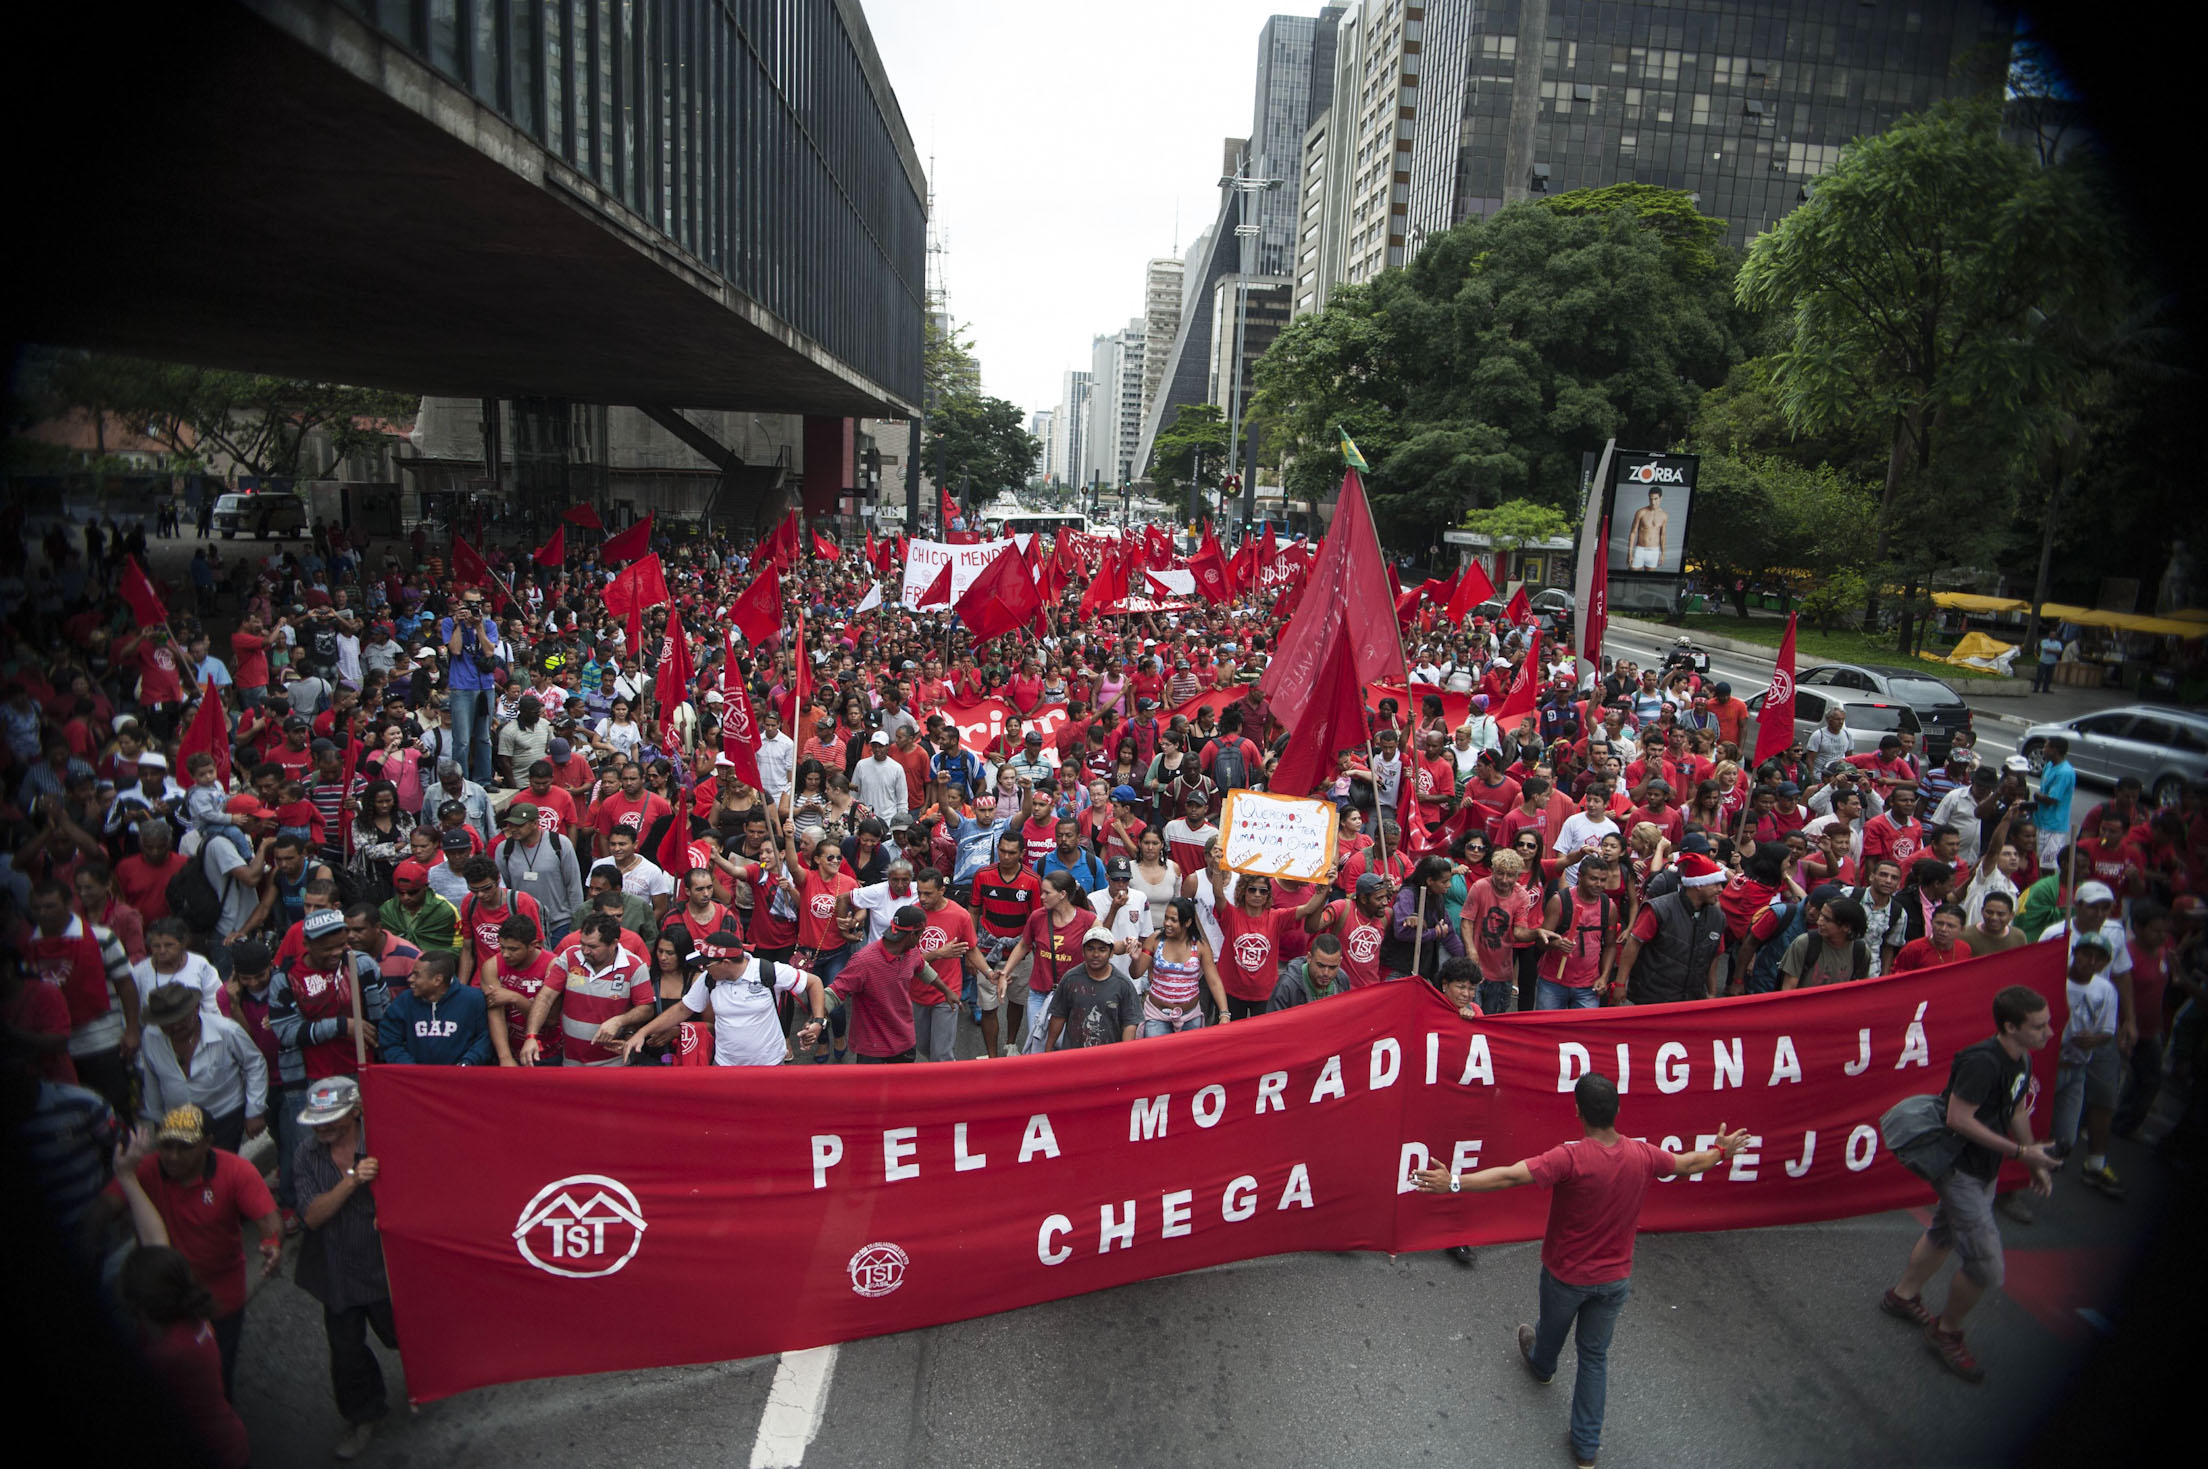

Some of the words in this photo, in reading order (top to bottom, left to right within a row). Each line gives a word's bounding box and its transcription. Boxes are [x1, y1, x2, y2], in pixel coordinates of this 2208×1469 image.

[1628, 460, 1683, 483] ZORBA
[912, 546, 949, 566] CHICO
[611, 973, 625, 991] 2
[414, 1018, 458, 1037] GAP
[810, 1113, 1061, 1189] PELA
[1128, 1032, 1496, 1142] MORADIA
[1556, 1034, 1802, 1095] DIGNA
[1843, 1000, 1929, 1077] JÁ
[1036, 1163, 1315, 1266] CHEGA
